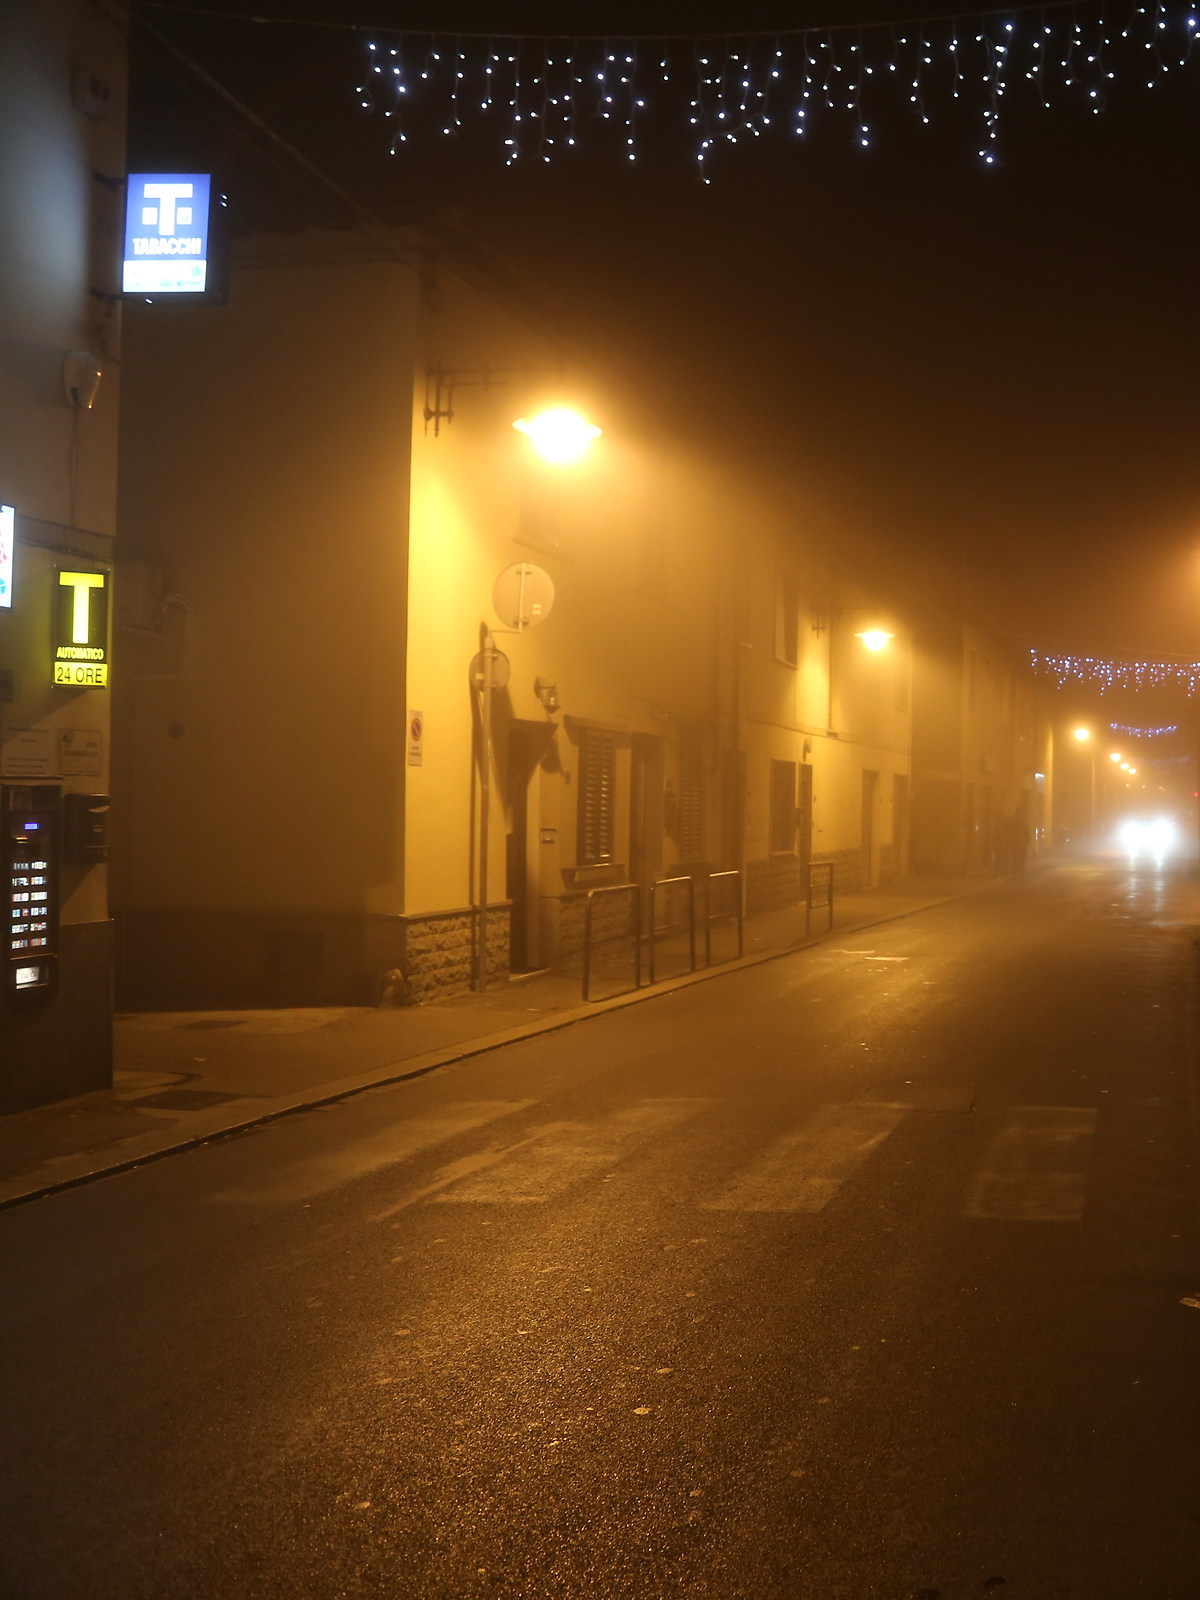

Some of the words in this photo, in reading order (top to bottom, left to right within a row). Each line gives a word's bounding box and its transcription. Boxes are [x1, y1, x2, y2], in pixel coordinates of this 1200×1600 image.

[143, 183, 194, 236] T
[132, 238, 202, 255] TABACCHI
[59, 571, 105, 644] T
[56, 647, 105, 660] AUTOMATICO
[57, 667, 71, 682] 24
[75, 667, 103, 683] ORE
